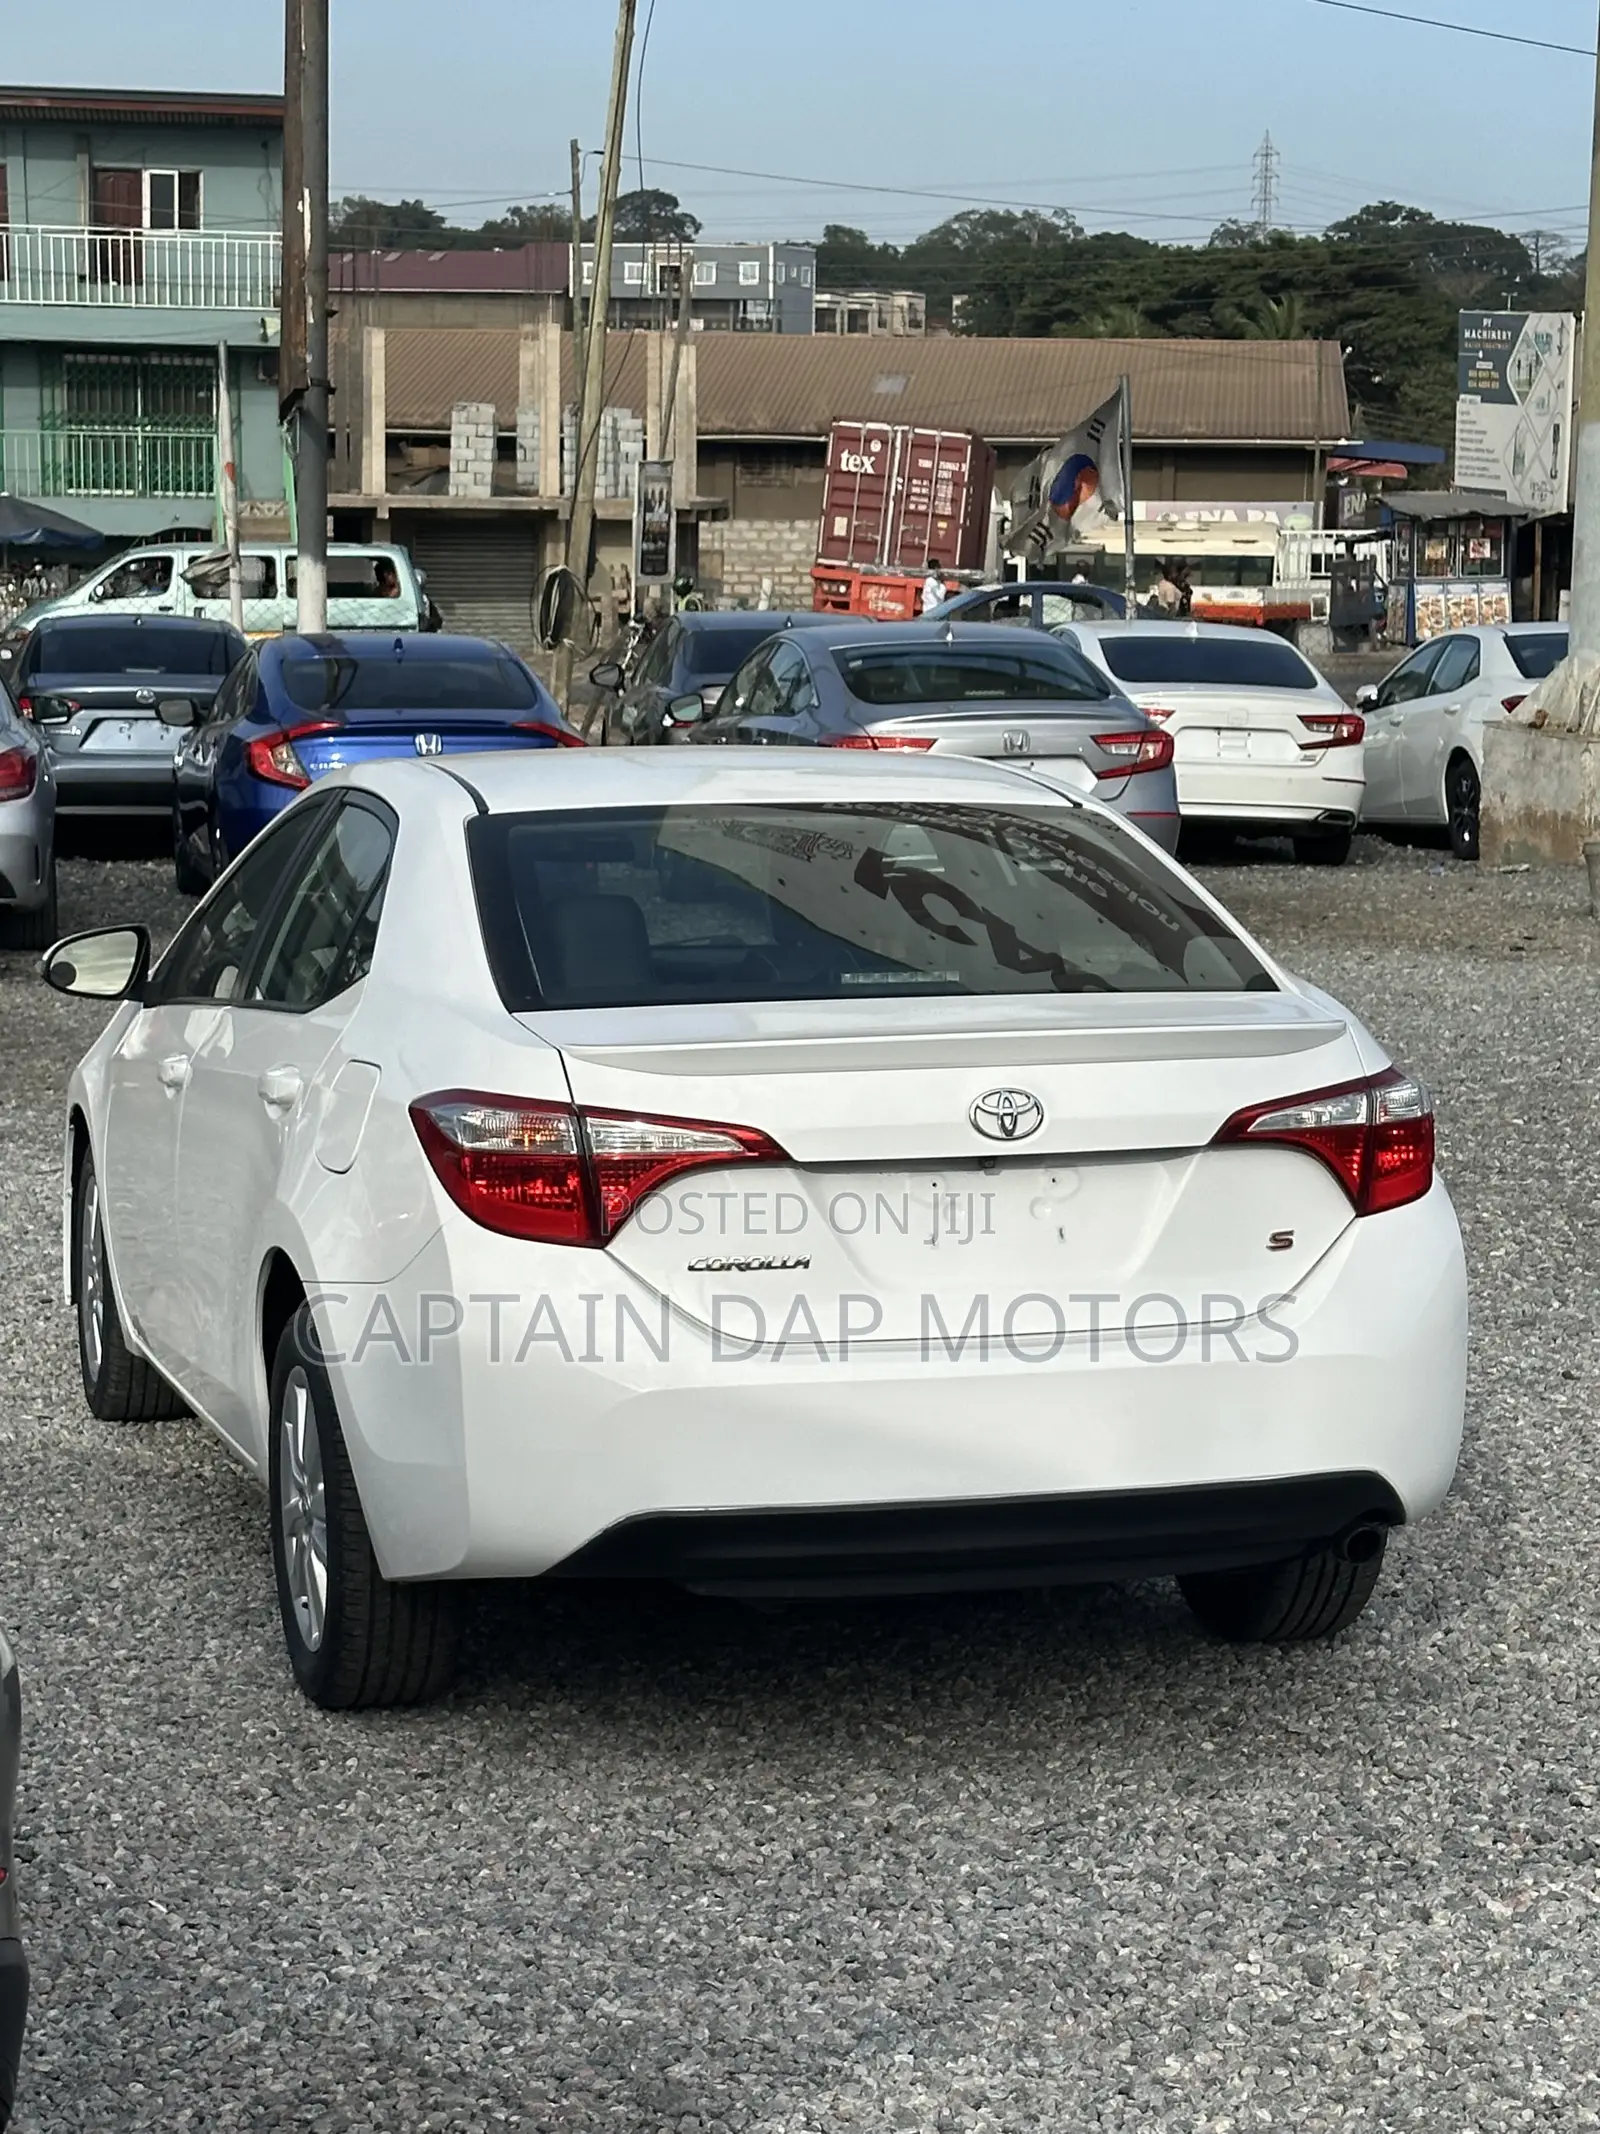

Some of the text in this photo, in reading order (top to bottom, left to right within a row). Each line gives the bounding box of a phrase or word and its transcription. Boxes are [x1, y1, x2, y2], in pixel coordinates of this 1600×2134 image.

[1463, 328, 1513, 341] MACHINERY
[840, 448, 876, 474] tex
[1265, 1229, 1296, 1253] S
[687, 1253, 812, 1272] COROLLA
